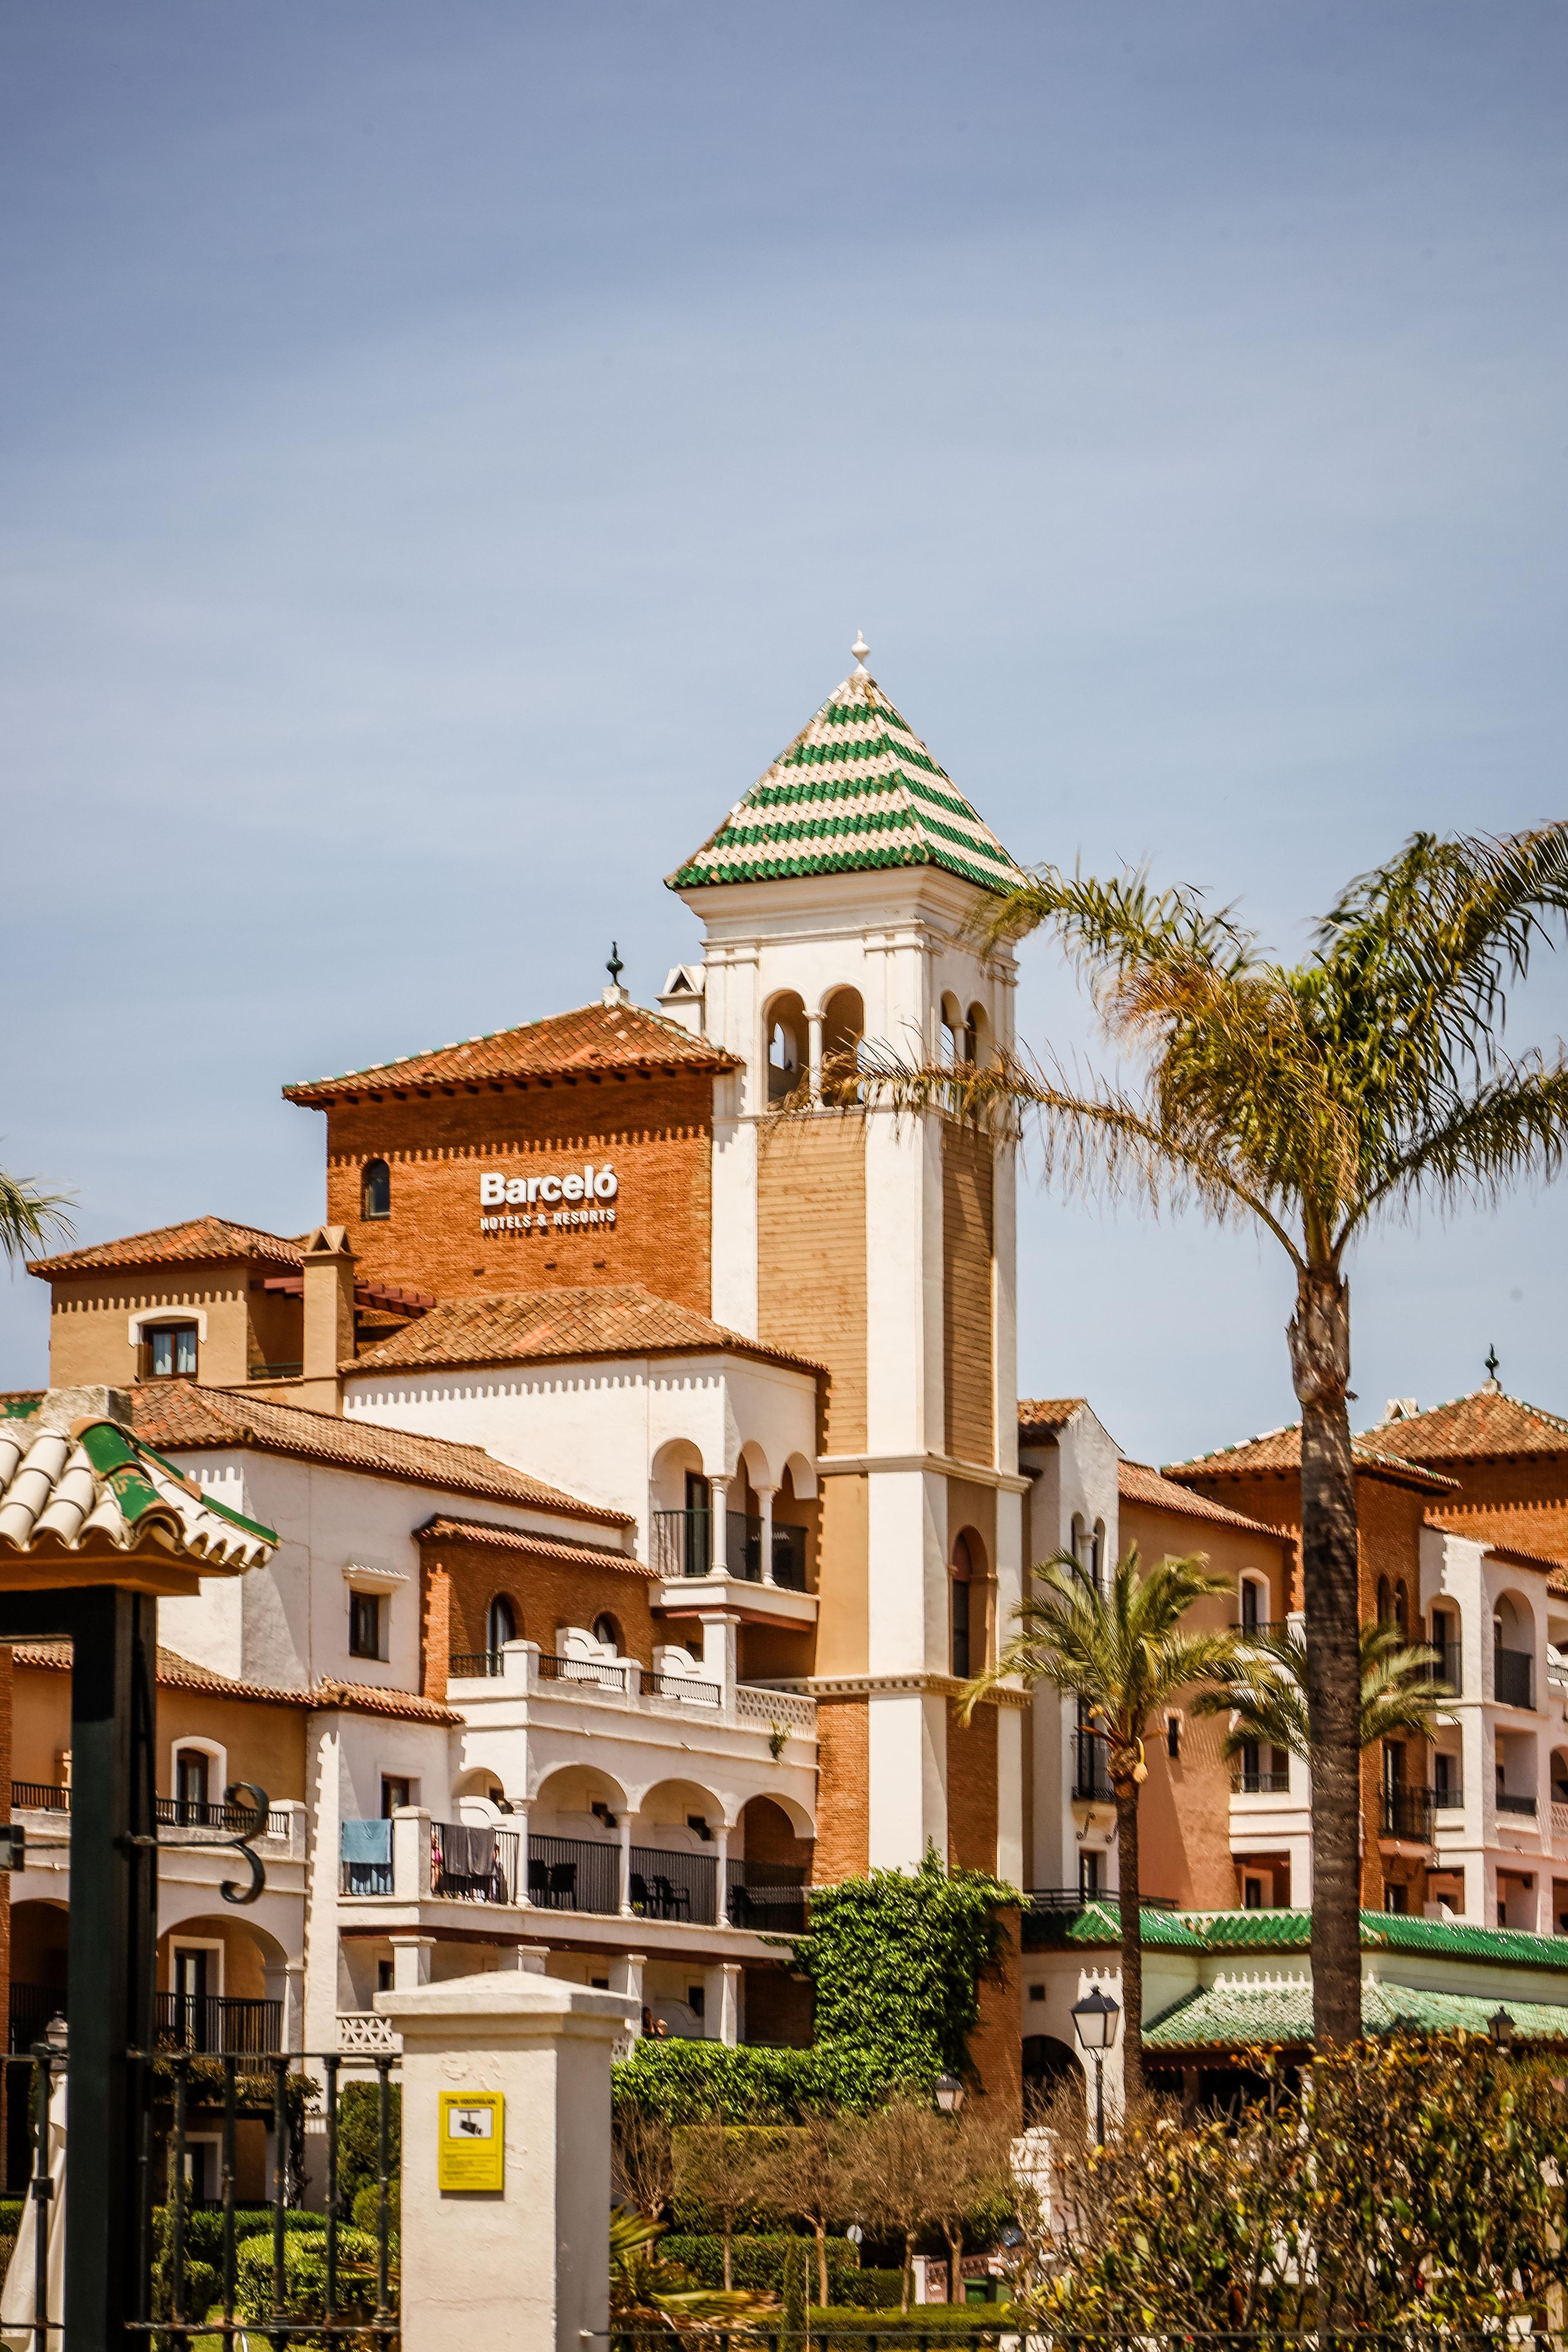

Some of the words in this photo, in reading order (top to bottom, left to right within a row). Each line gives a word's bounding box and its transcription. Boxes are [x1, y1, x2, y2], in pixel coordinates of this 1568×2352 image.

[480, 1164, 618, 1206] Barceló
[480, 1214, 532, 1230] HOTELS
[537, 1213, 548, 1227] &
[553, 1208, 616, 1226] RESORTS
